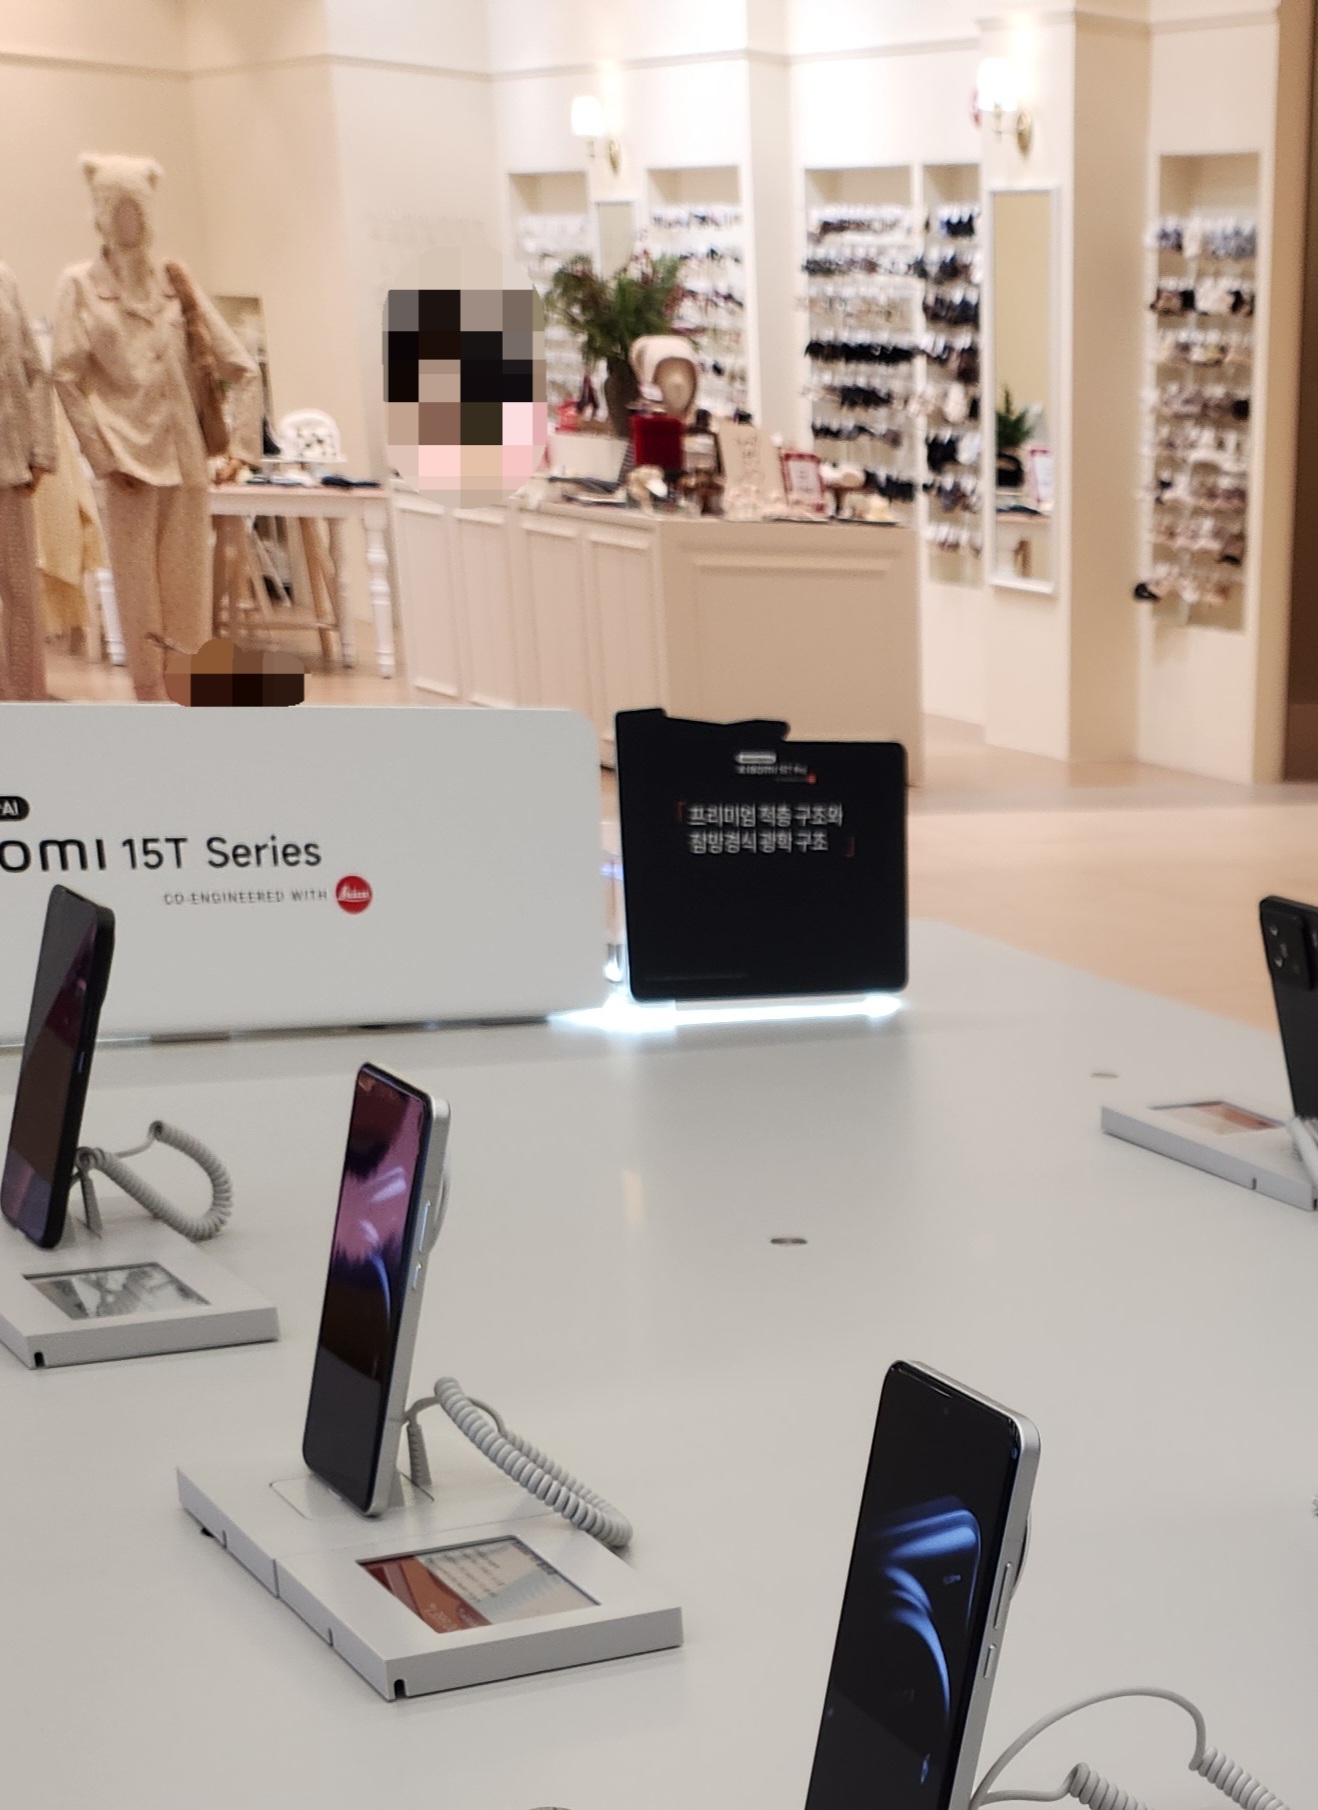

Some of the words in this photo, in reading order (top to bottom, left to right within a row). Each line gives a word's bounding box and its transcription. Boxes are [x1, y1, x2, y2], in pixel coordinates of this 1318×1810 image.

[121, 837, 189, 870] 15T
[206, 834, 323, 868] Series
[291, 889, 328, 902] WITH
